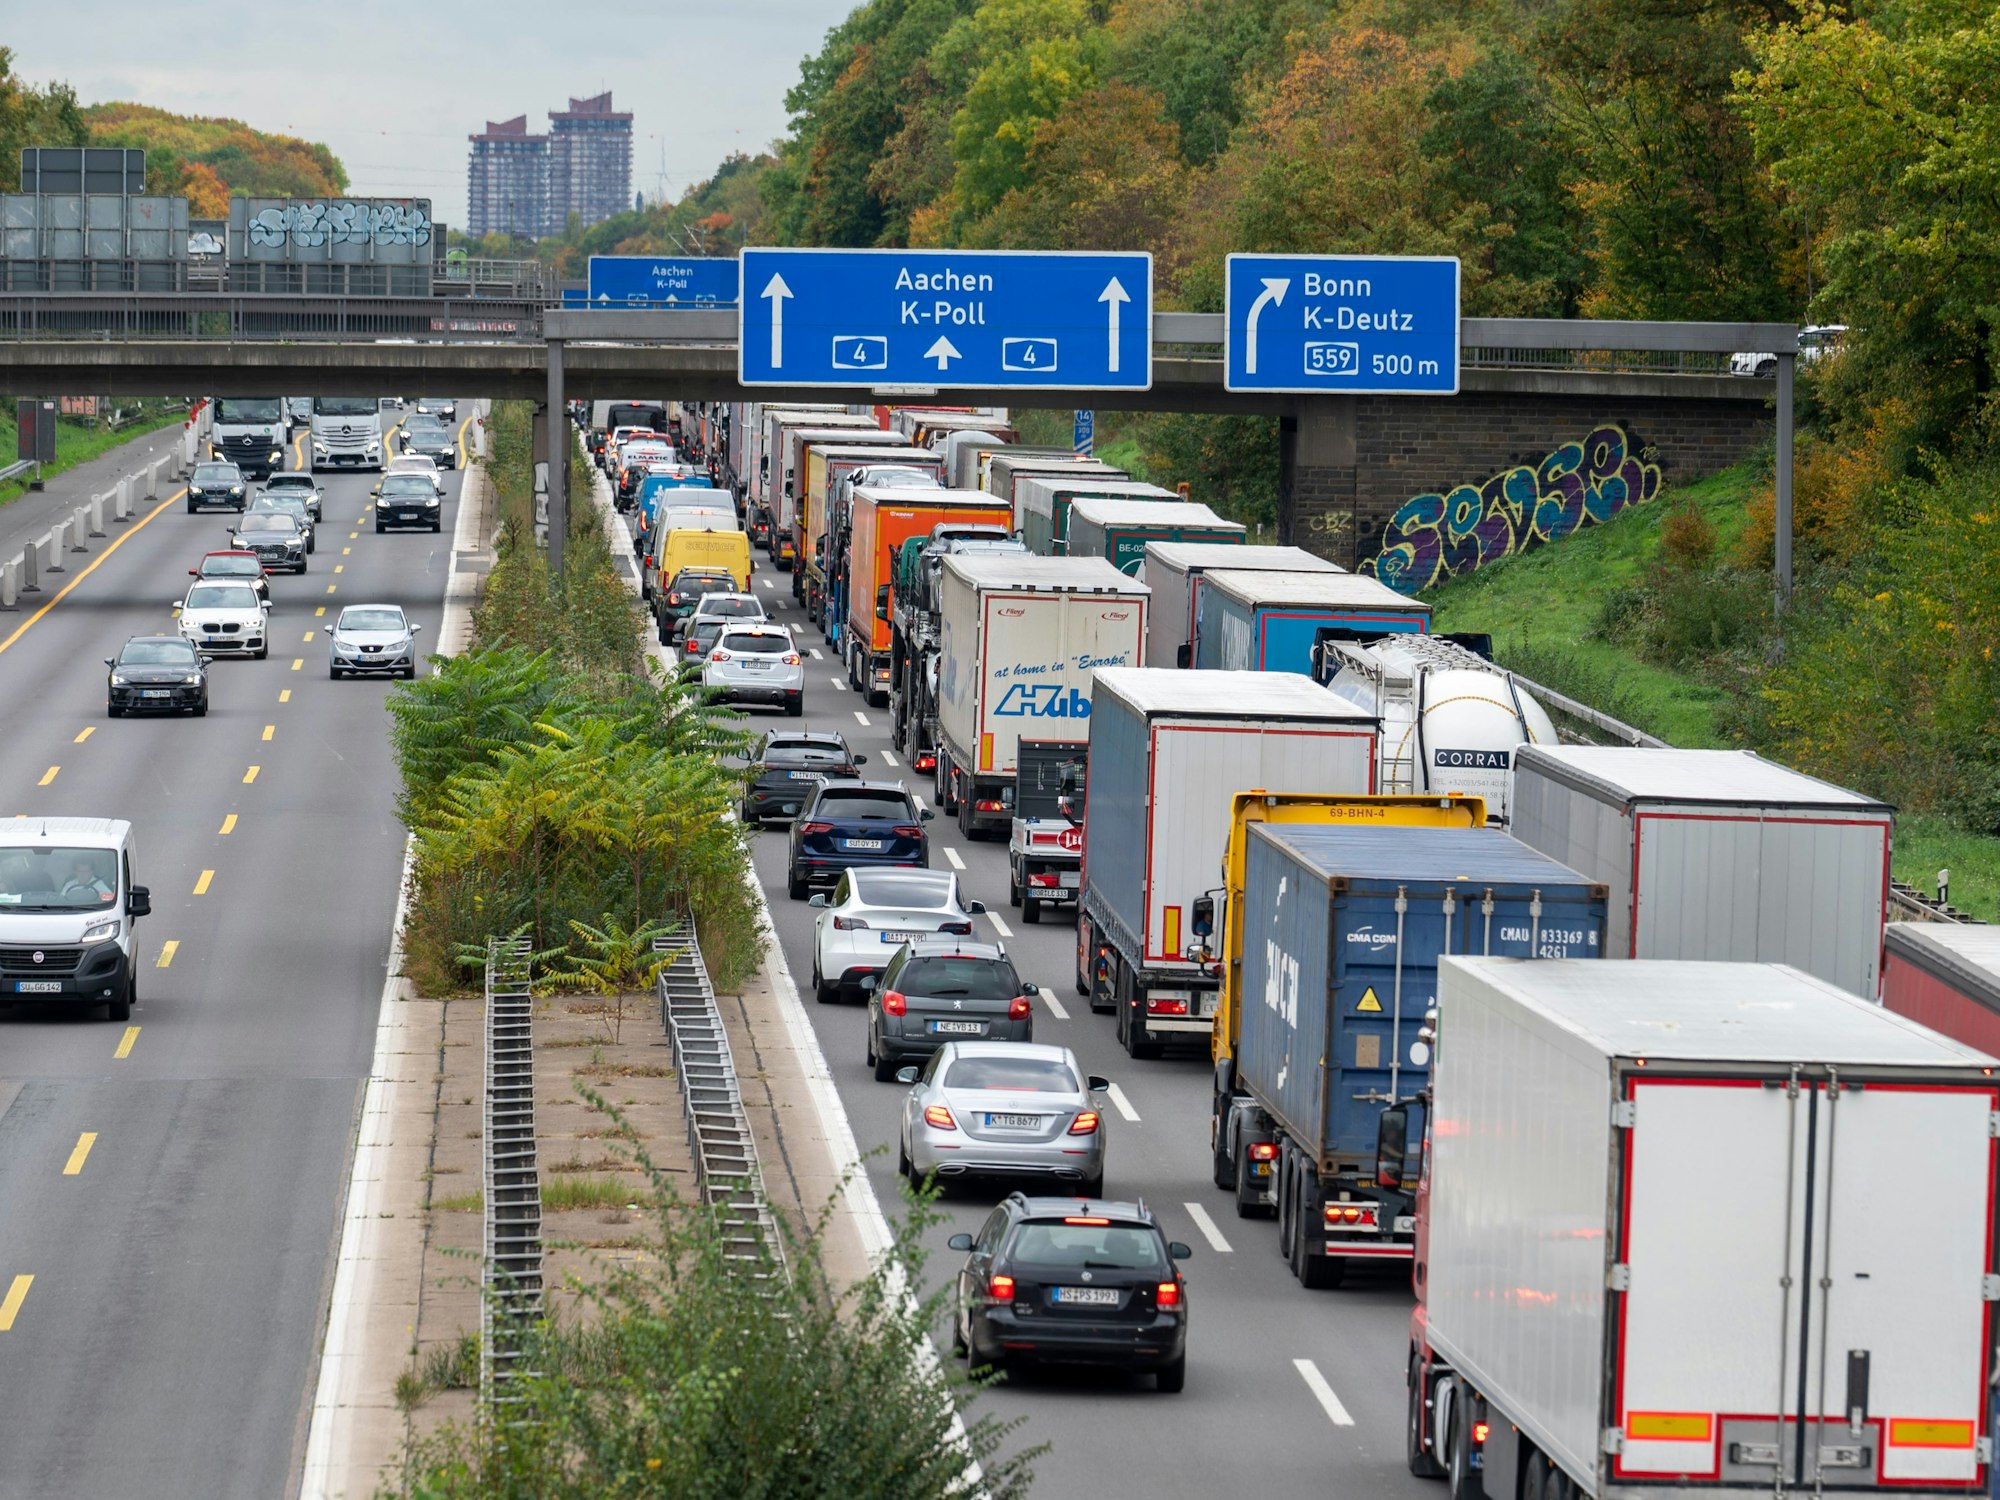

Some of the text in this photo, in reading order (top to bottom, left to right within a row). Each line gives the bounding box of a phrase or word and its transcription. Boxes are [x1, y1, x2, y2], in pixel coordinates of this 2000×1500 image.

[652, 265, 693, 276] Aachen
[657, 279, 687, 289] K-Poll
[894, 267, 993, 292] Aachen
[1303, 272, 1371, 297] Bonn
[901, 301, 985, 325] K-Poll
[1303, 307, 1413, 332] K-Deutz
[852, 343, 867, 363] 4
[1022, 345, 1036, 365] 4
[1311, 347, 1439, 376] 559 500 m
[685, 541, 736, 552] SERVICE
[1119, 544, 1146, 553] BE-02
[1005, 608, 1026, 617] Fliegl
[1109, 612, 1129, 620] Fliegl
[994, 667, 1008, 678] at
[1013, 663, 1046, 676] home
[1051, 662, 1065, 672] in
[1436, 752, 1506, 767] CORRAL
[1330, 807, 1385, 818] 69-BHN-4
[886, 932, 894, 941] DA
[1346, 933, 1396, 944] CMA CGM
[1500, 927, 1597, 945] CMAU 833369 8
[20, 983, 60, 991] SU GG 142
[940, 1022, 977, 1031] NE YB 13
[991, 1114, 1039, 1126] K TG 8677
[1059, 1288, 1117, 1302] HS PS 1993
